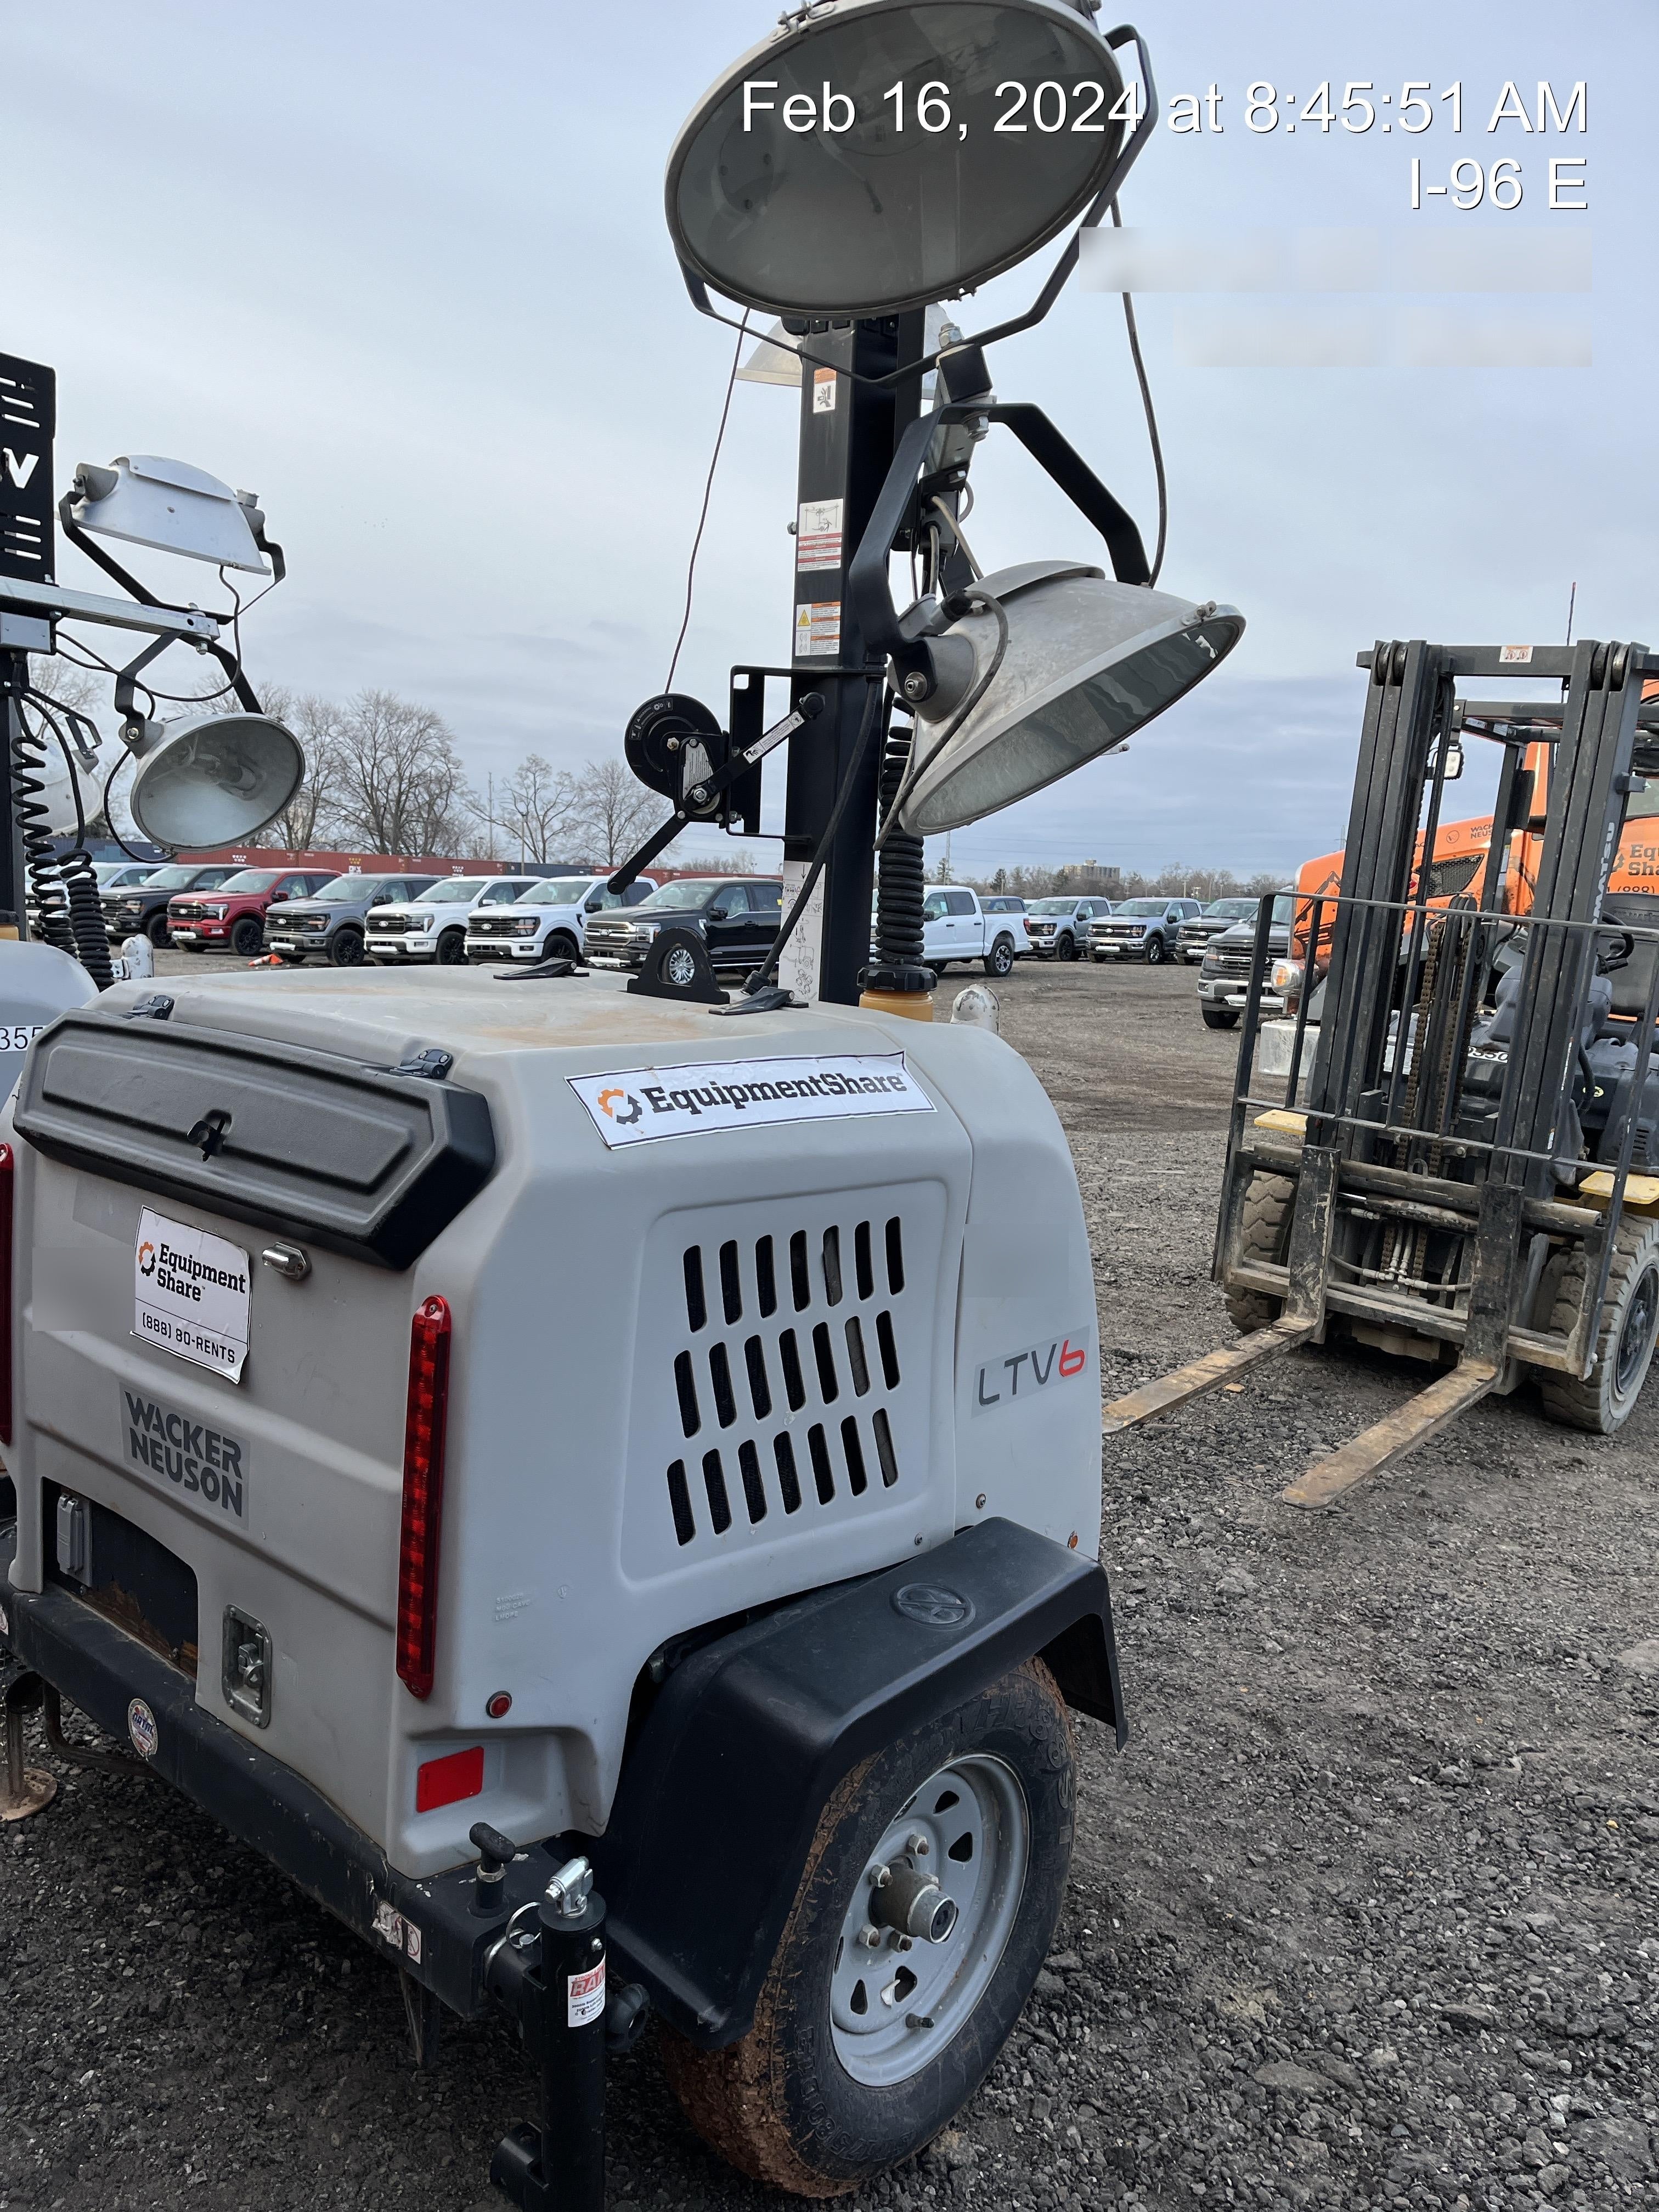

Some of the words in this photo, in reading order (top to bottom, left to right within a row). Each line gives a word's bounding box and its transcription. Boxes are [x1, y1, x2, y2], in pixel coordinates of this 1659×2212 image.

[1629, 844, 1659, 861] Eq
[640, 1071, 907, 1115] EquipmentShare
[156, 1271, 202, 1302] Share
[158, 1242, 246, 1295] Equipment
[142, 1311, 172, 1340] (888)
[174, 1328, 236, 1364] 80-RENTS
[978, 1339, 1086, 1407] LTV6
[123, 1391, 244, 1481] WACKER
[129, 1427, 243, 1518] NEUSON
